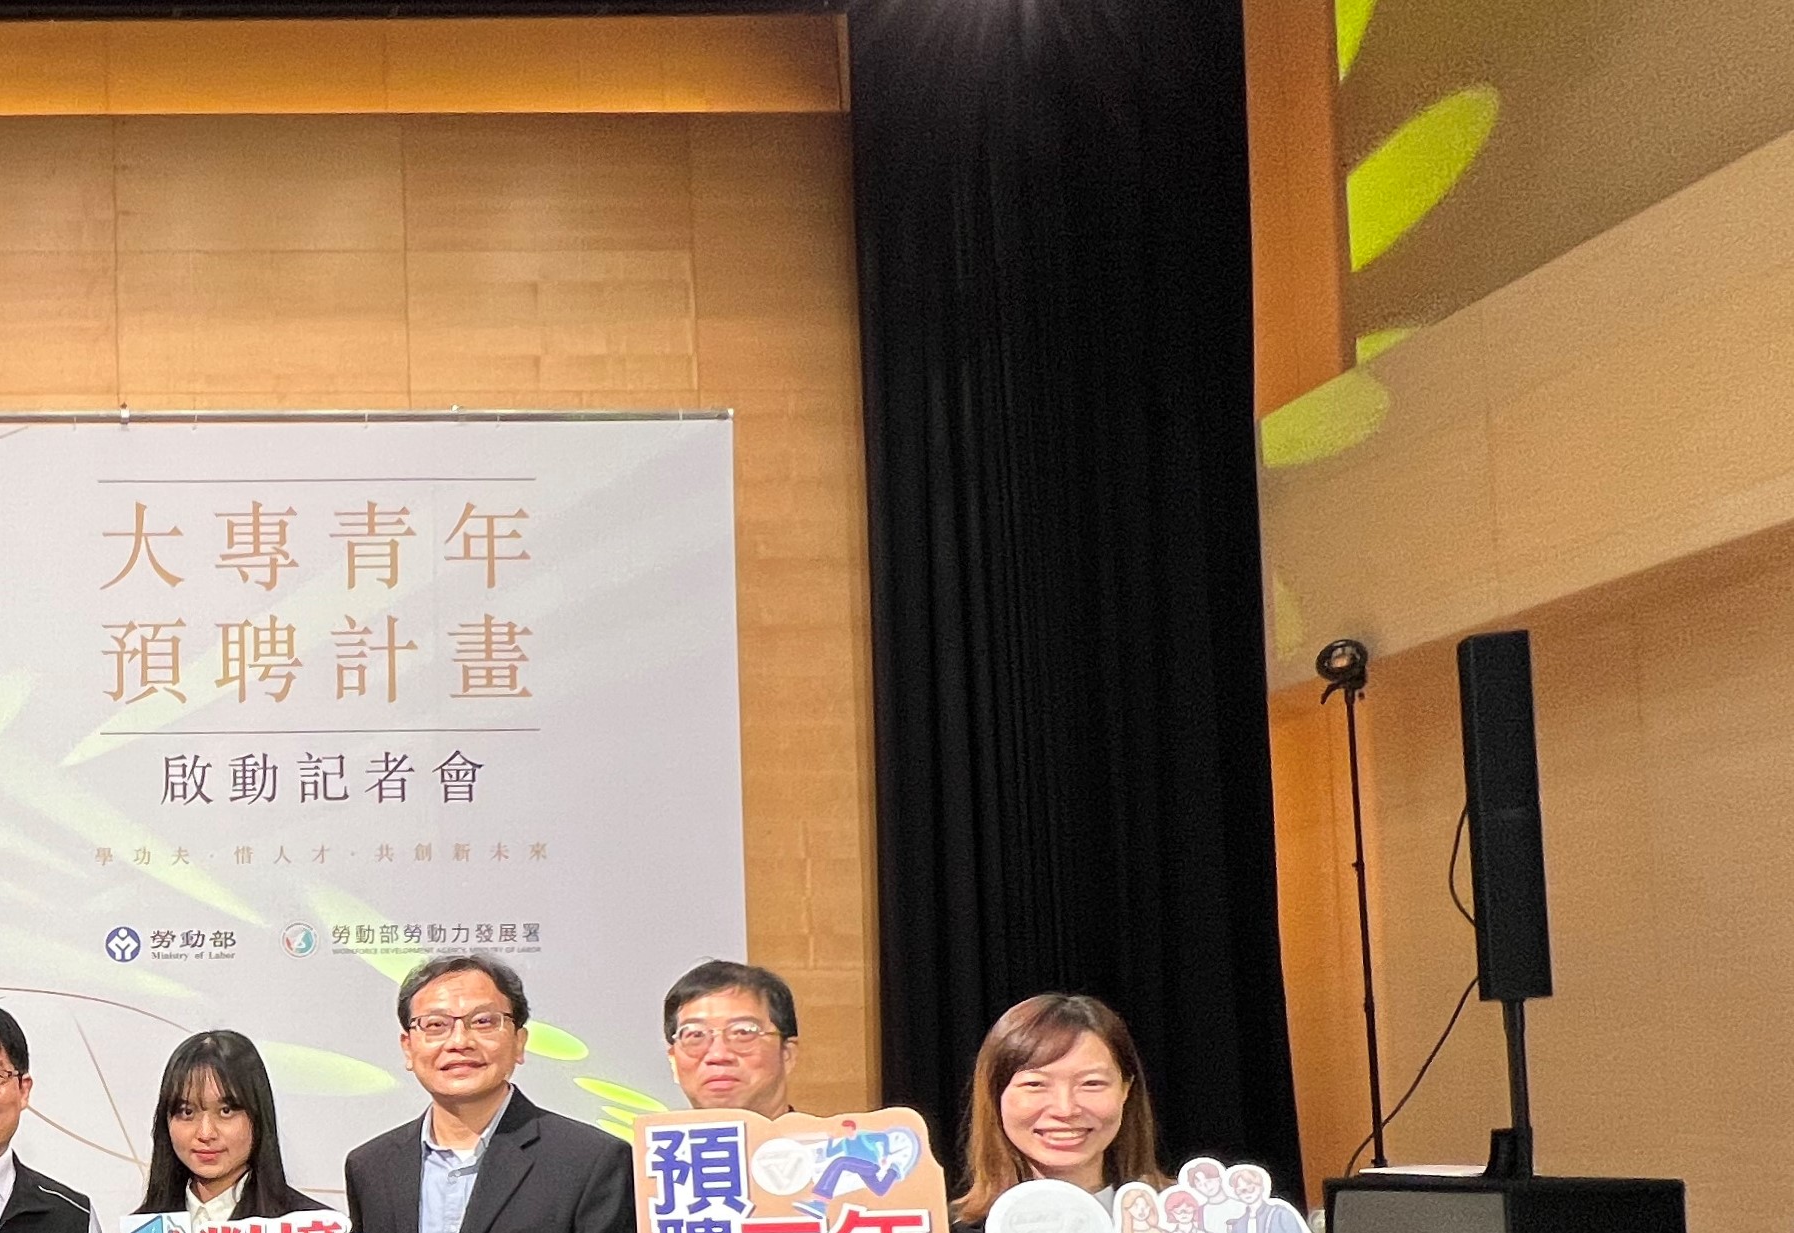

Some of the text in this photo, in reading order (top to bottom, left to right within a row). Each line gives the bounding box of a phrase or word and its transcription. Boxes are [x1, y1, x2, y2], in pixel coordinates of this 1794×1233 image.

[99, 500, 533, 592] 大專青年
[101, 613, 534, 705] 預聘計畫
[160, 749, 485, 806] 啟動記者會
[150, 929, 237, 950] 勞動部
[331, 922, 541, 944] 勞動部勞動力發展署
[151, 951, 189, 961] Ministry
[208, 951, 236, 960] Labor
